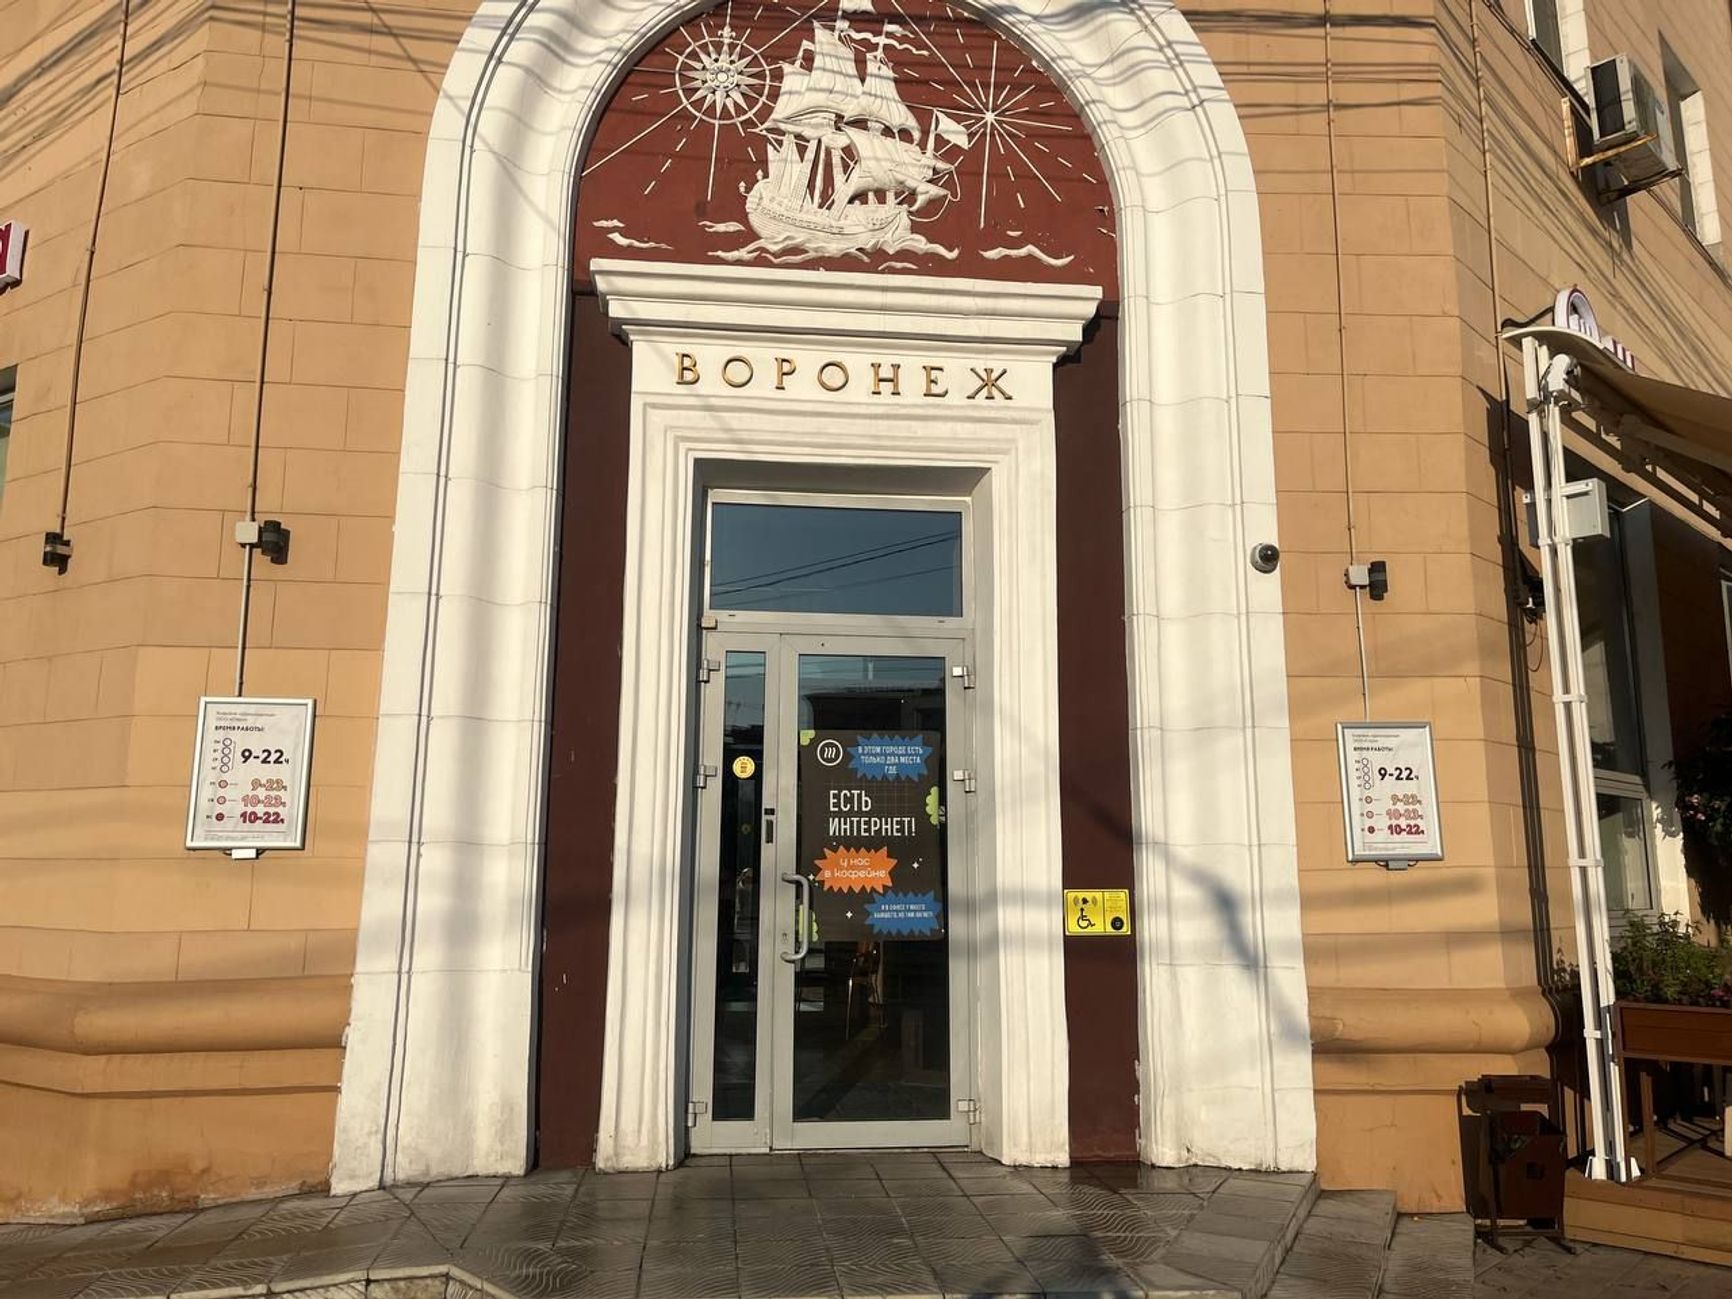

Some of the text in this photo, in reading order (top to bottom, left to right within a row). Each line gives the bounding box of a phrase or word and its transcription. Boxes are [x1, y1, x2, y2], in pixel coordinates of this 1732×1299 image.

[675, 351, 1014, 401] ВОРОНЕЖ
[864, 745, 881, 754] ЭТОМ
[882, 745, 906, 754] ГОРОДЕ
[907, 745, 923, 755] ЕСТЬ
[860, 755, 921, 764] ТОЛЬКО ДВА МЕСТА
[829, 790, 872, 812] ЕСТЬ
[829, 817, 916, 837] ИНТЕРНЕТ!
[849, 858, 871, 866] нас
[834, 868, 886, 880] кофейне
